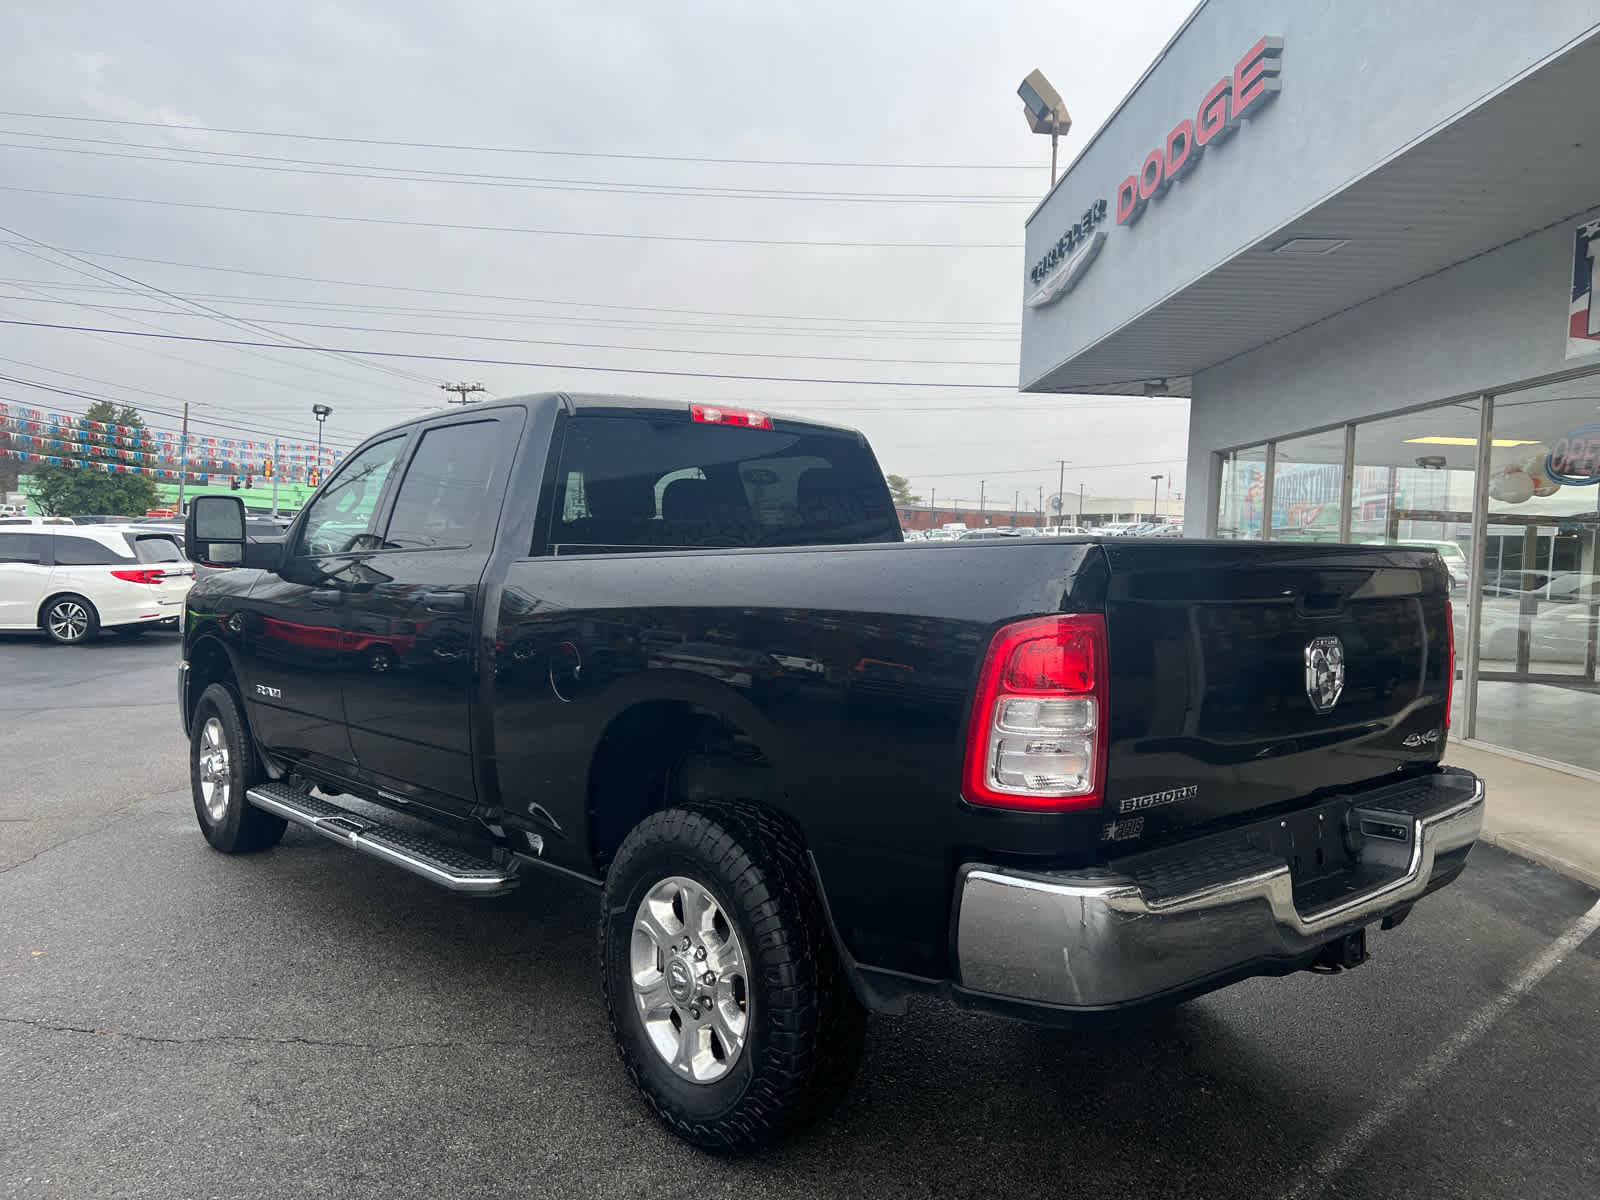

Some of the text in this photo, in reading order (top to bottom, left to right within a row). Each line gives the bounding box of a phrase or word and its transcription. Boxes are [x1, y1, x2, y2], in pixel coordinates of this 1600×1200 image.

[1117, 36, 1281, 226] DODGE
[1551, 437, 1600, 475] OPE
[255, 684, 282, 699] RAM
[1119, 784, 1199, 814] BIGHORN
